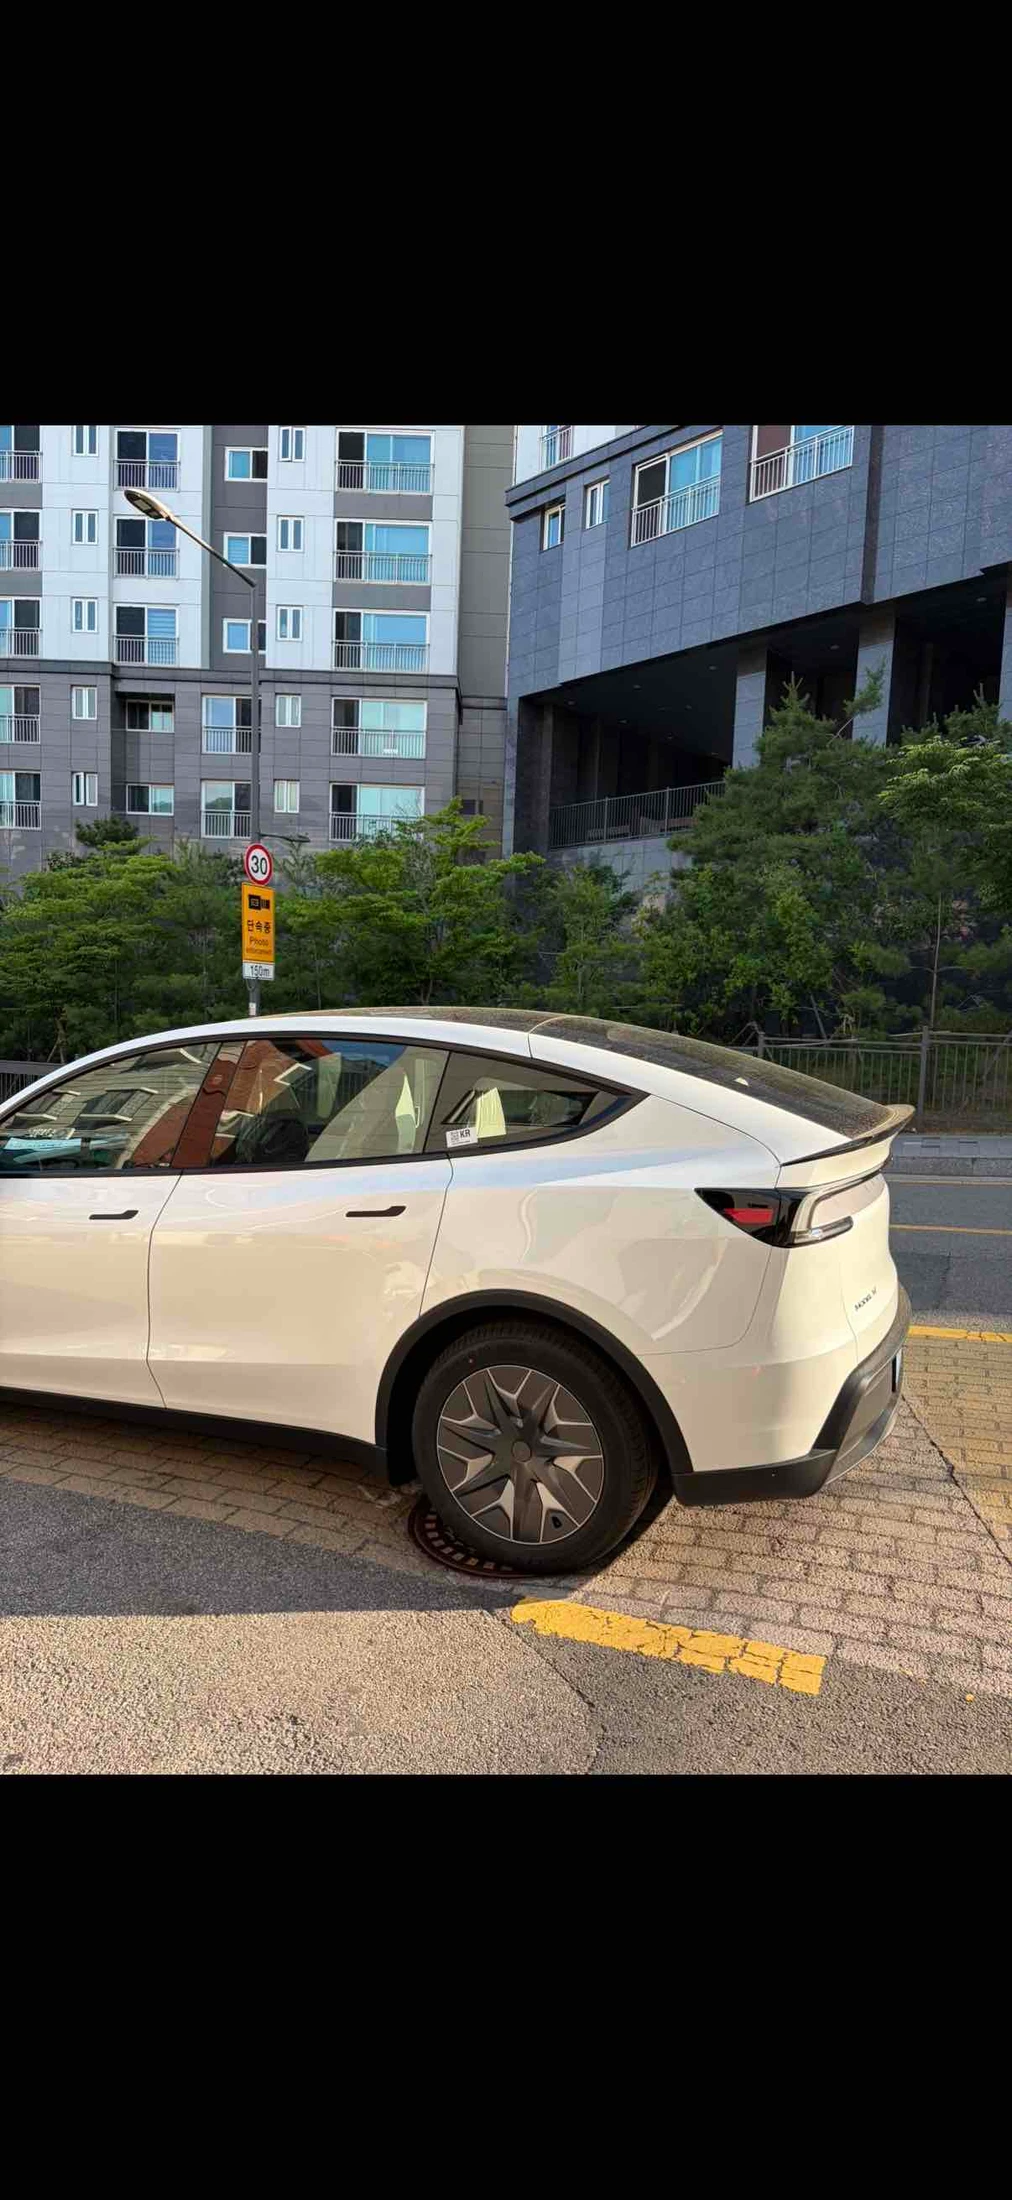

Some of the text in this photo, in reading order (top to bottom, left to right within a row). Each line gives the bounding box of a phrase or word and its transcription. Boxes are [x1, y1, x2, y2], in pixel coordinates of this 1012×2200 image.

[251, 855, 268, 875] 30
[247, 919, 271, 934] 단속중
[250, 965, 270, 977] 150m
[460, 1129, 471, 1138] KR
